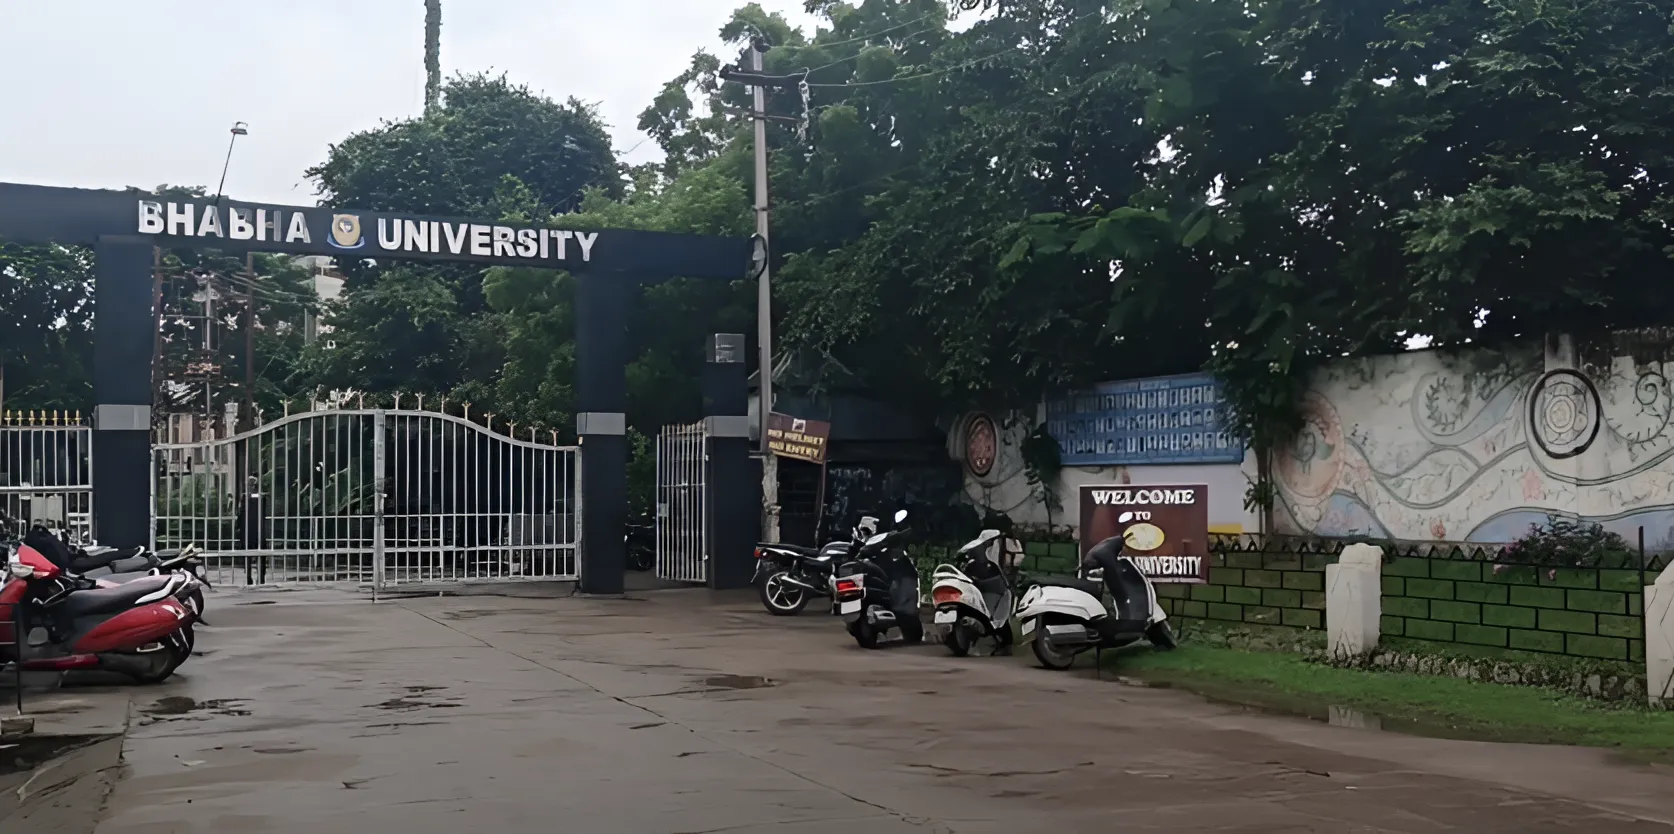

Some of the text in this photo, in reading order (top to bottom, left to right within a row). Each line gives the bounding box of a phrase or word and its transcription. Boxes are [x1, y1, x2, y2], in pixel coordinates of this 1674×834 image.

[138, 200, 598, 261] BHABHA UNIVERSITY
[1091, 489, 1195, 505] WELCOME
[1134, 511, 1151, 521] TO
